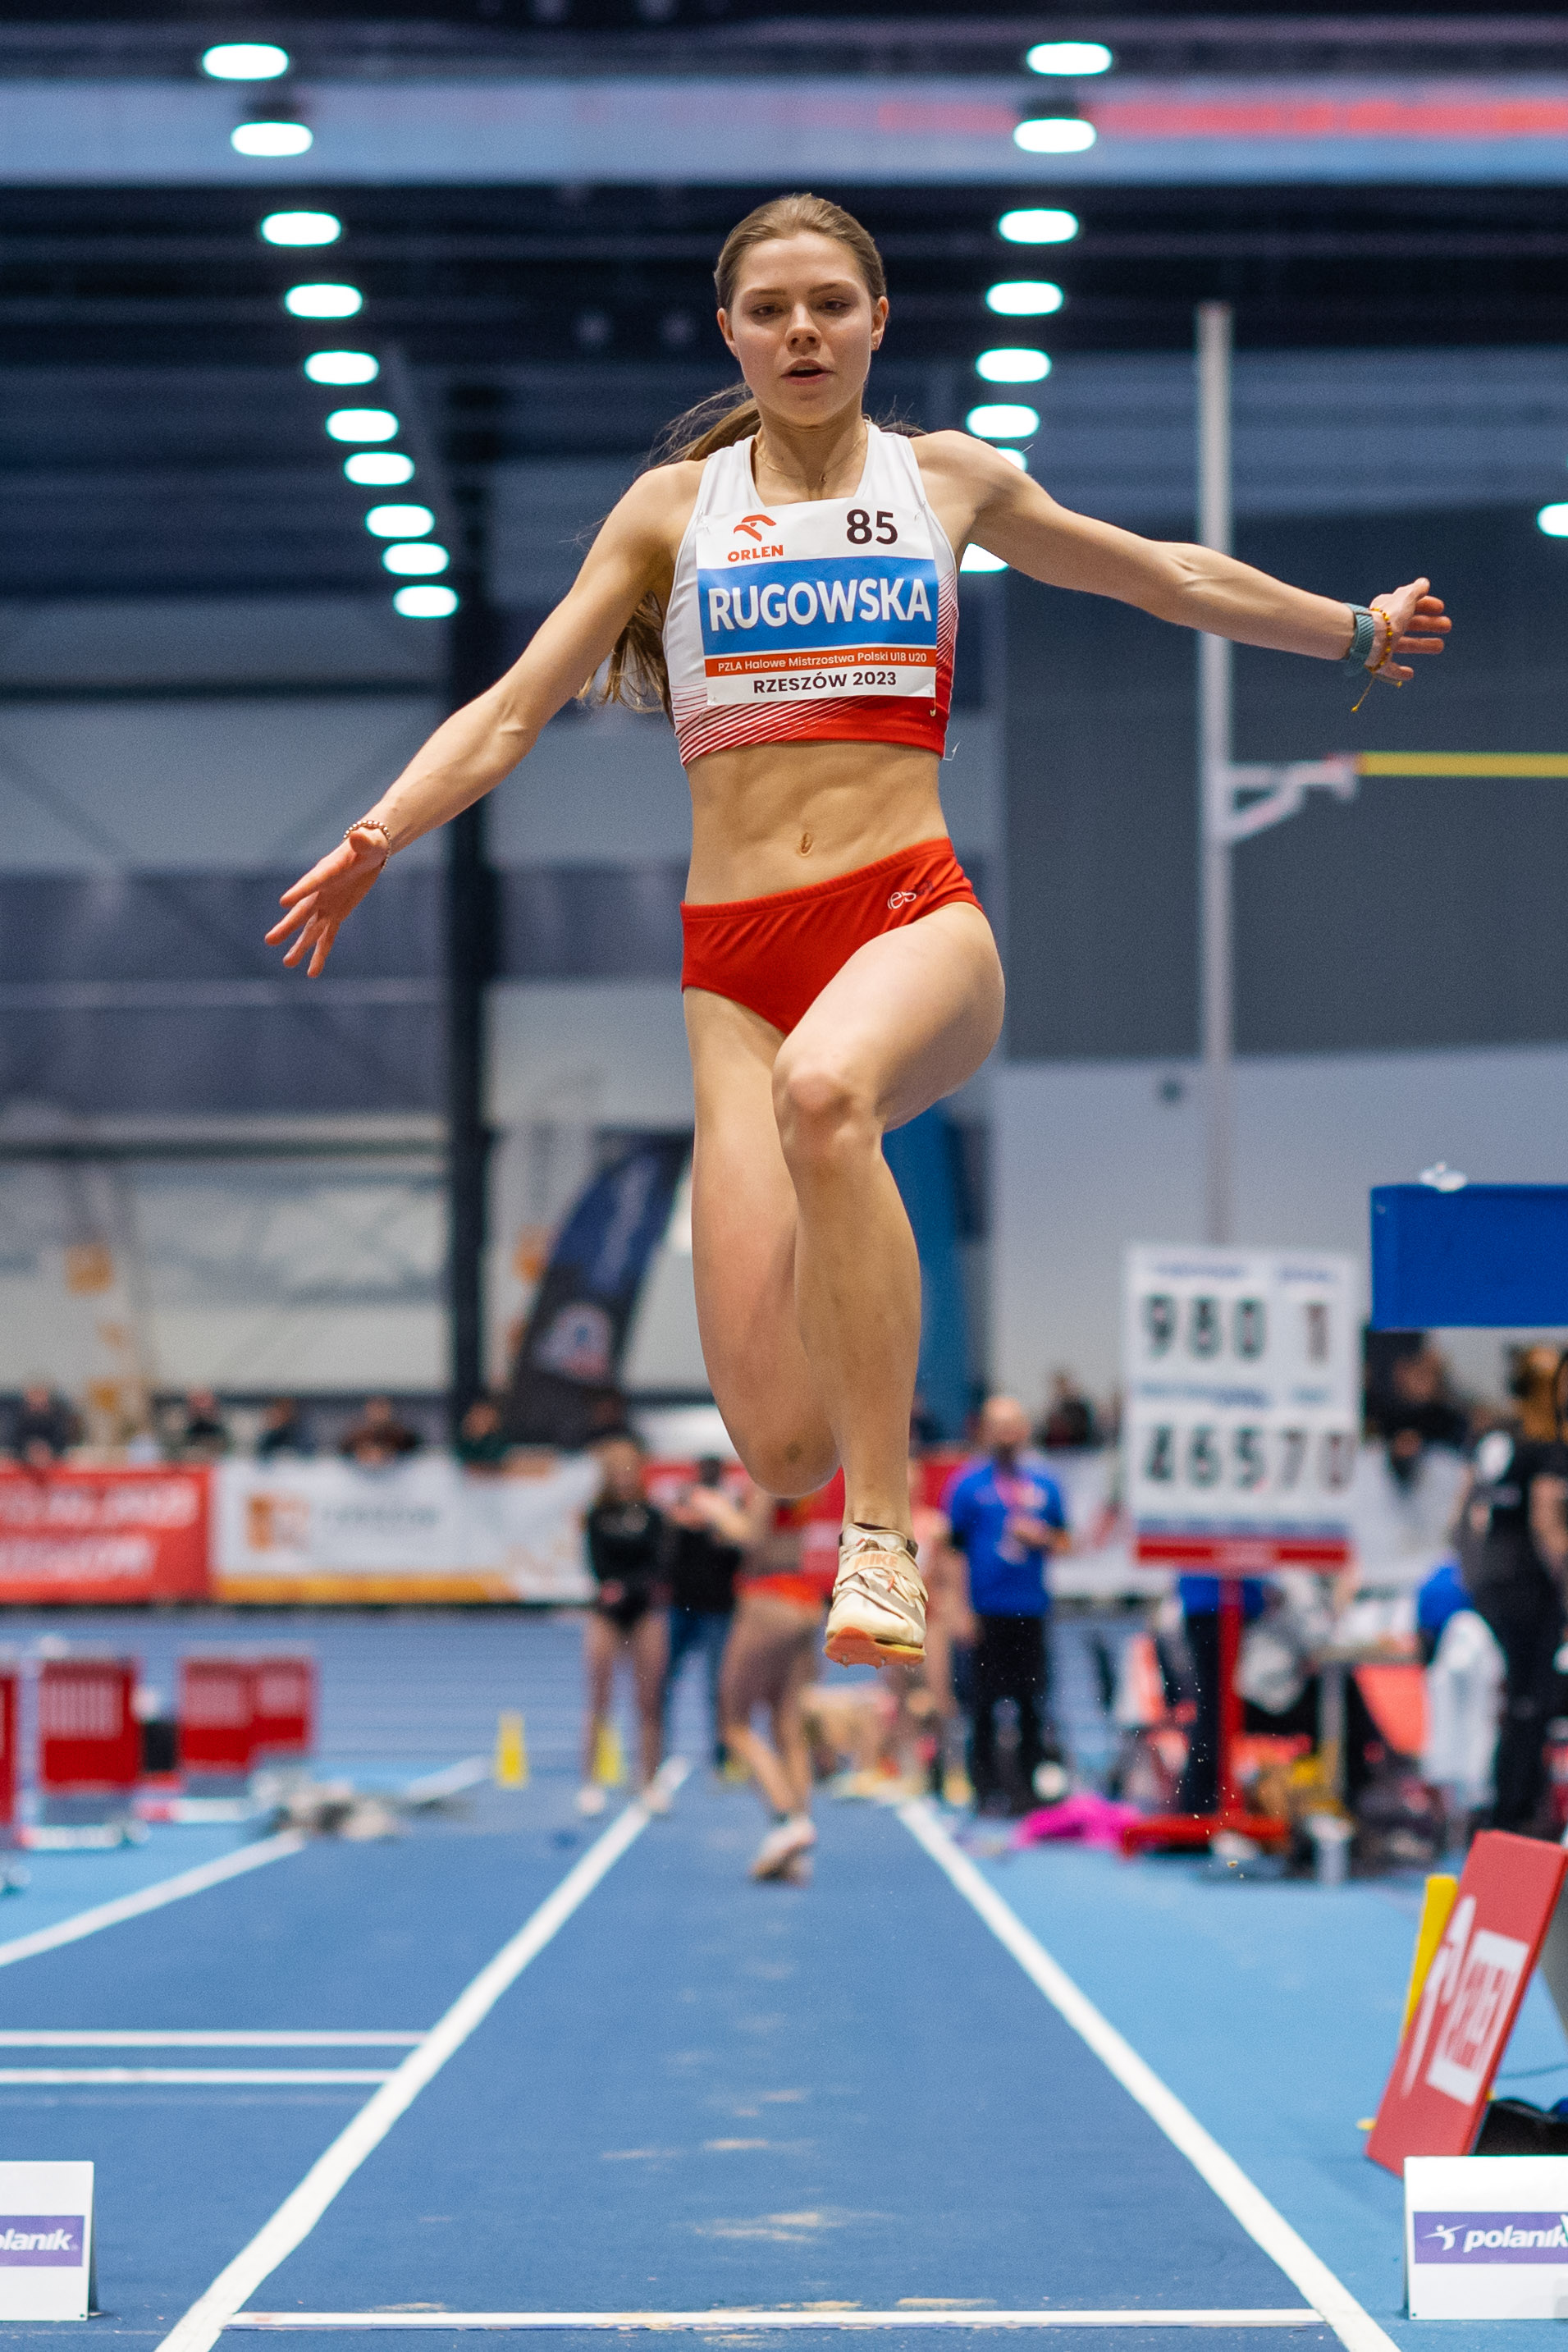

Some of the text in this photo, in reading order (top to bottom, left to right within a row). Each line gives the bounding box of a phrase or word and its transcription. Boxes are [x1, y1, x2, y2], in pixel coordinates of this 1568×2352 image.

[846, 509, 898, 545] 85
[727, 544, 784, 562] ORLEN
[708, 578, 932, 632] RUGOWSKA
[718, 651, 927, 672] PZLA Halowe Mistrzostwa Polski U18 U20
[753, 670, 897, 693] RZESZÓW 2023
[854, 1553, 898, 1569] NIKE
